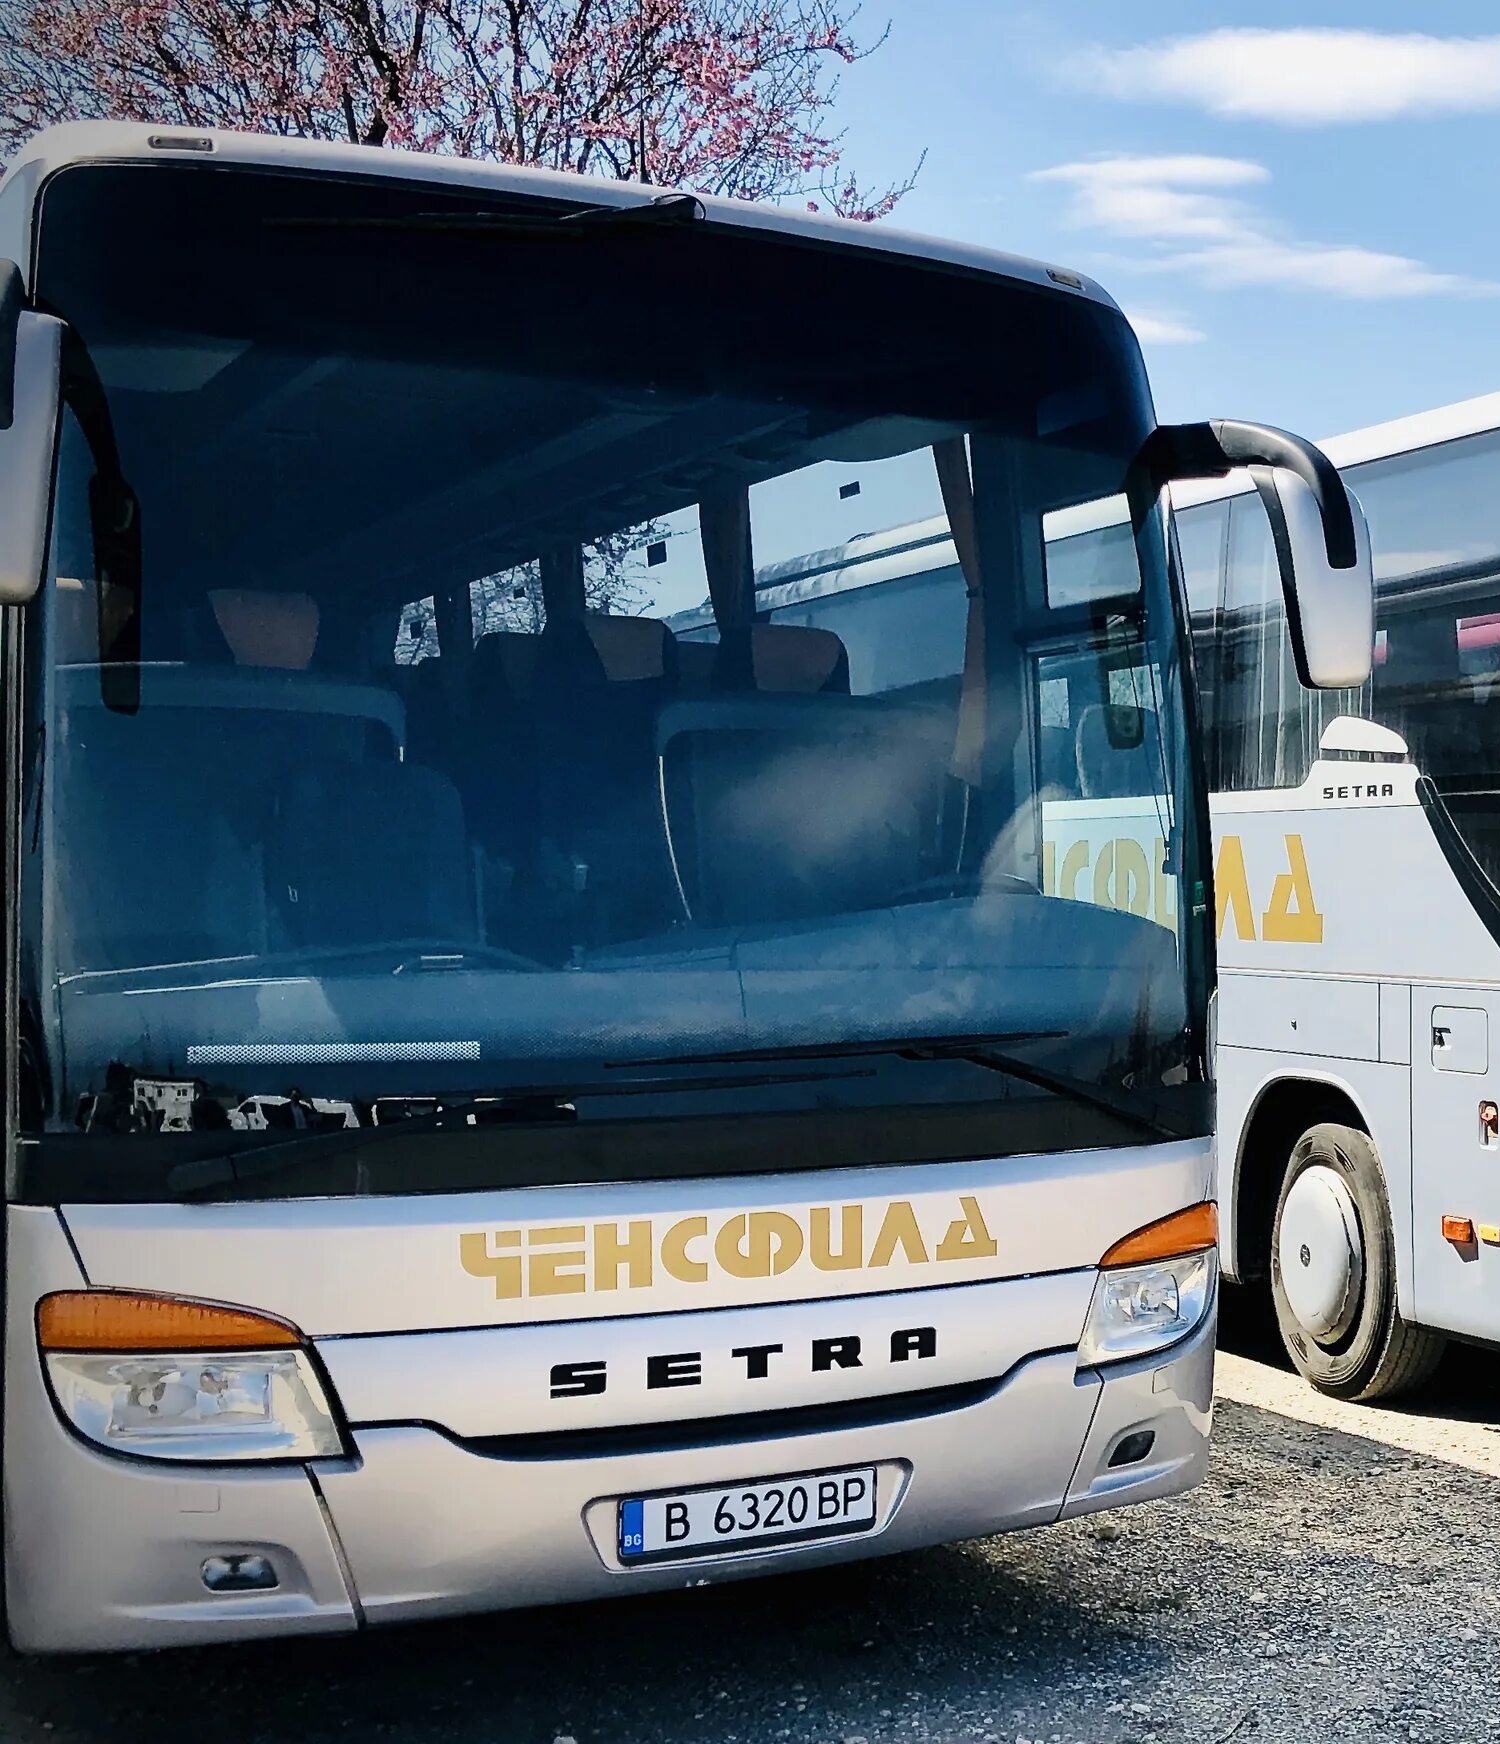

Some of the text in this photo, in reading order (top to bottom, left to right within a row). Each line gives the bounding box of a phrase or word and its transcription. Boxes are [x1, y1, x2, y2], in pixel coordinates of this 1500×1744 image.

[1322, 784, 1394, 799] SETRA
[459, 1196, 999, 1300] ЧЕНСФИЛД
[549, 1325, 938, 1400] SETRA
[713, 1485, 809, 1535] 6320
[623, 1533, 643, 1548] BG
